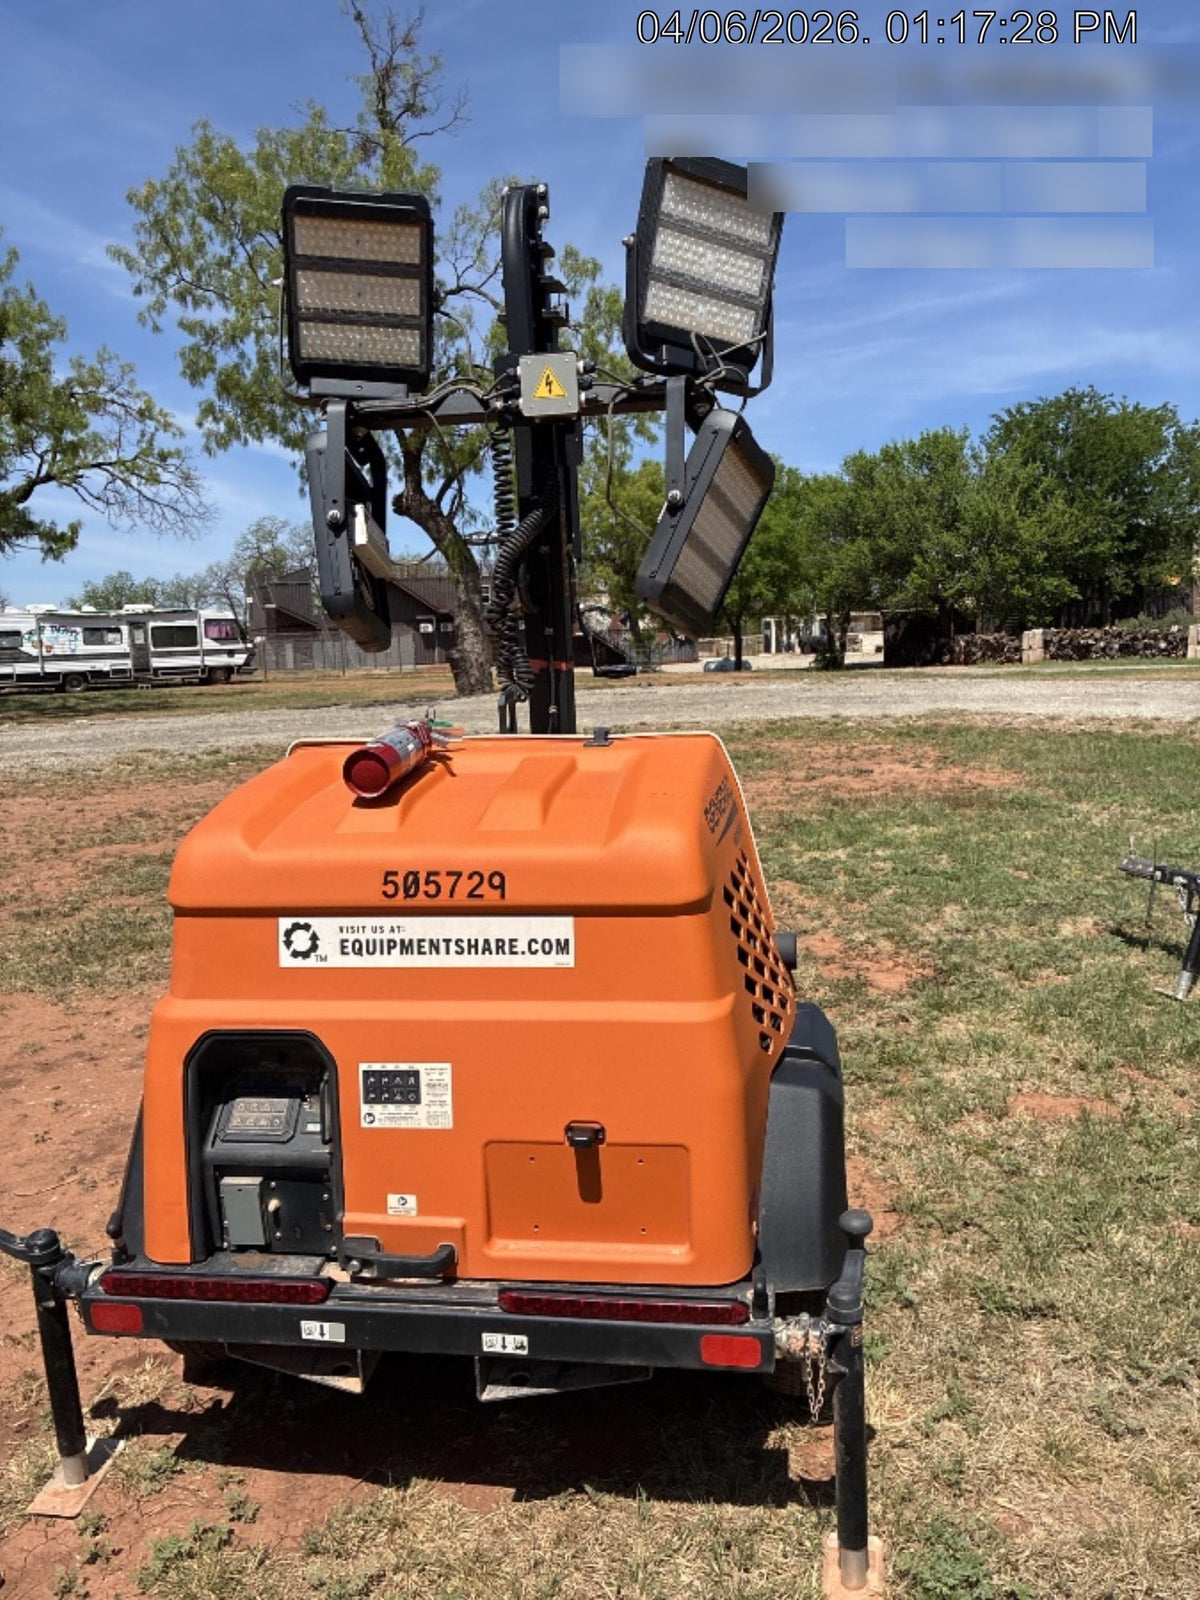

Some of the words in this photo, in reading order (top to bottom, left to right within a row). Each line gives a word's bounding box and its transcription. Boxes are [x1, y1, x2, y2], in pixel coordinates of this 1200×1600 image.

[339, 925, 366, 934] VISIT
[371, 925, 385, 934] US
[340, 938, 570, 957] EQUIPMENTSHARE.COM
